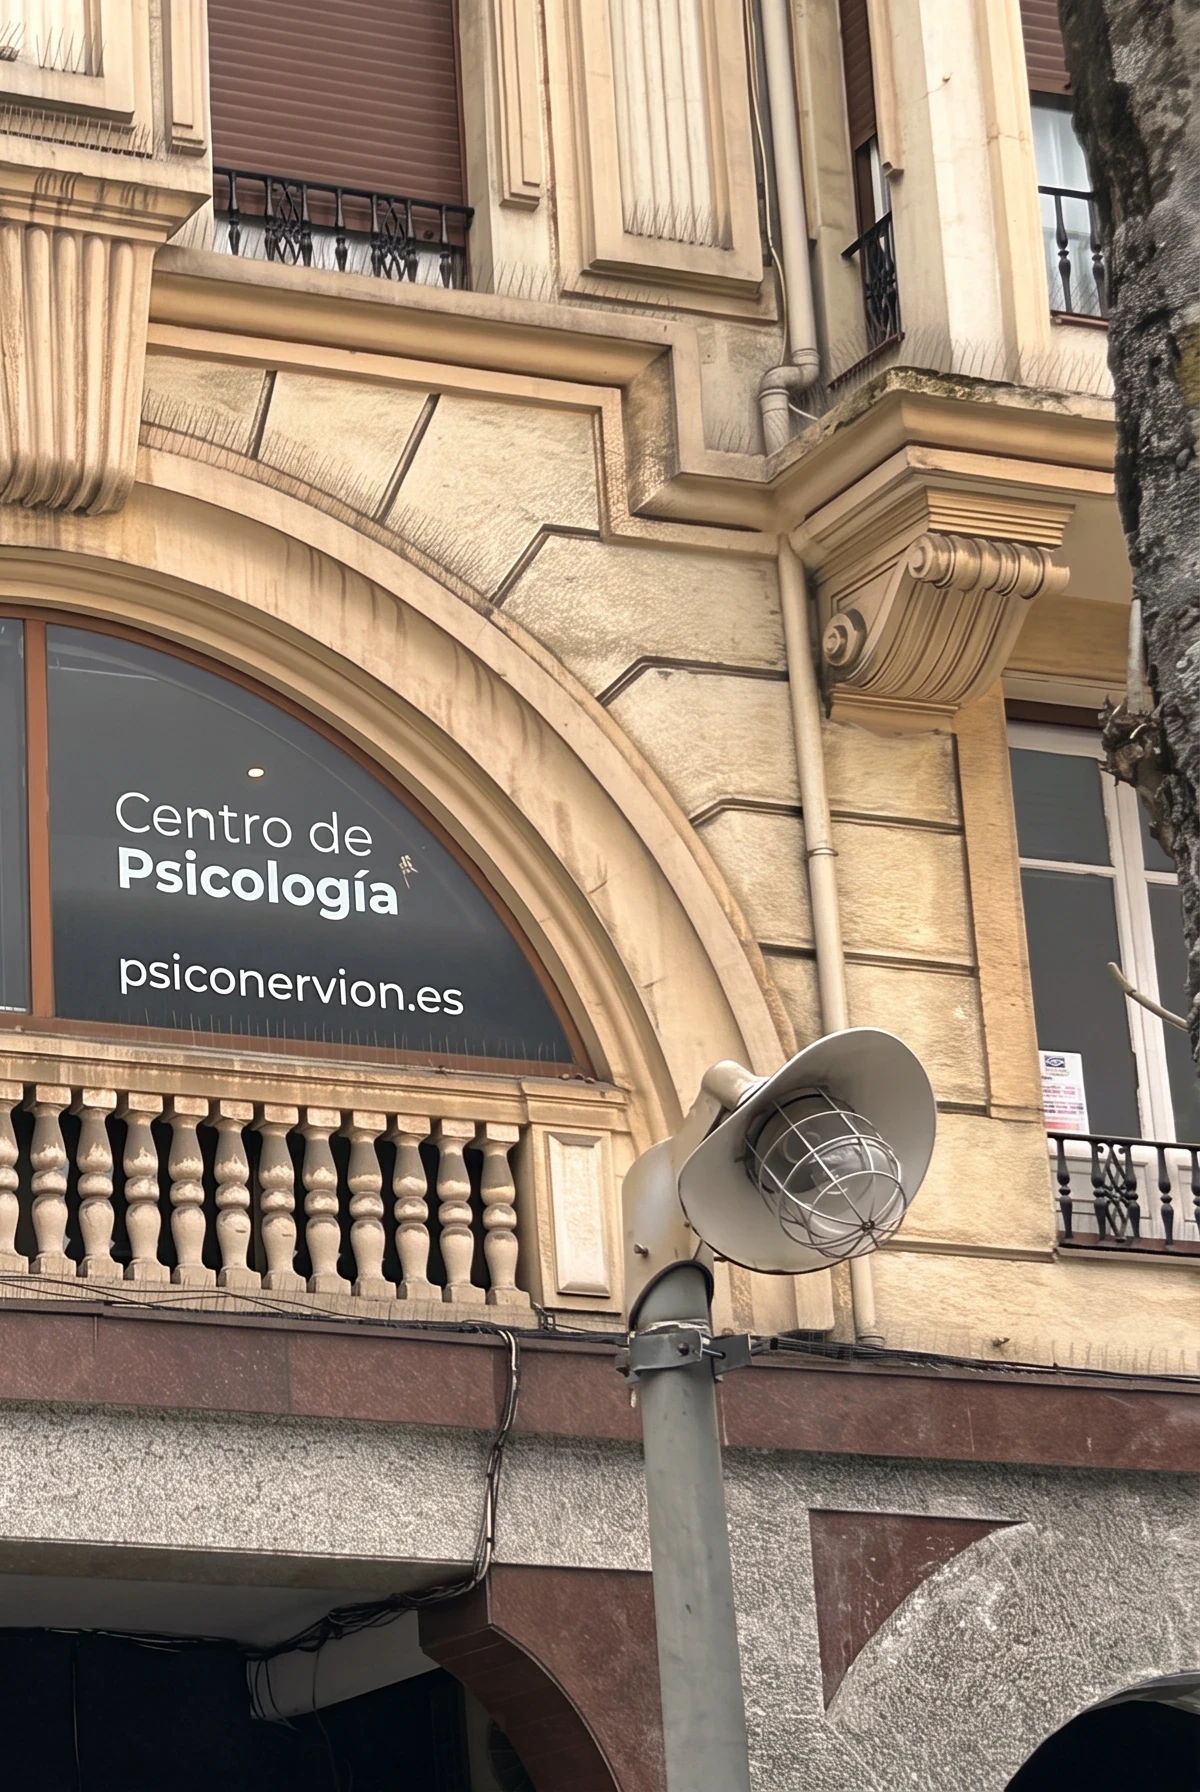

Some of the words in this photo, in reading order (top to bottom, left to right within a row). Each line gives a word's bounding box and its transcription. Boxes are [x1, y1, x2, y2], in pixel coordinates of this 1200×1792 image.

[115, 791, 293, 848] Centro
[309, 811, 373, 857] de
[118, 846, 399, 921] Psicología
[120, 952, 465, 1016] psiconervion.es
